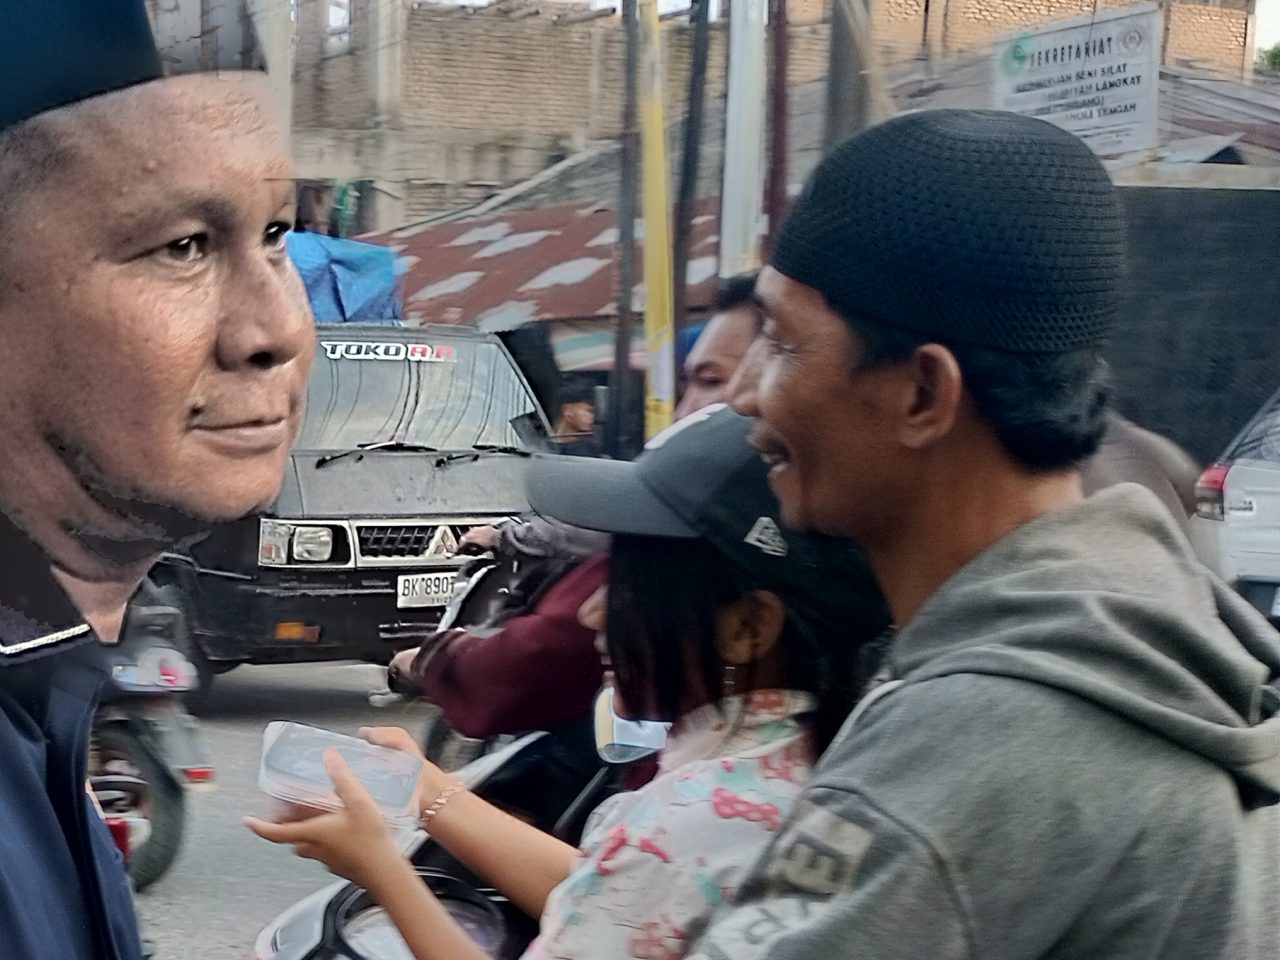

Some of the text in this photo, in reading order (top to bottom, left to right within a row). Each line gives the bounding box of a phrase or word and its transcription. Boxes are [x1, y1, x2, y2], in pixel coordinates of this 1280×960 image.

[1100, 62, 1128, 77] SILAT
[321, 341, 406, 360] TOKO
[402, 578, 419, 597] BK
